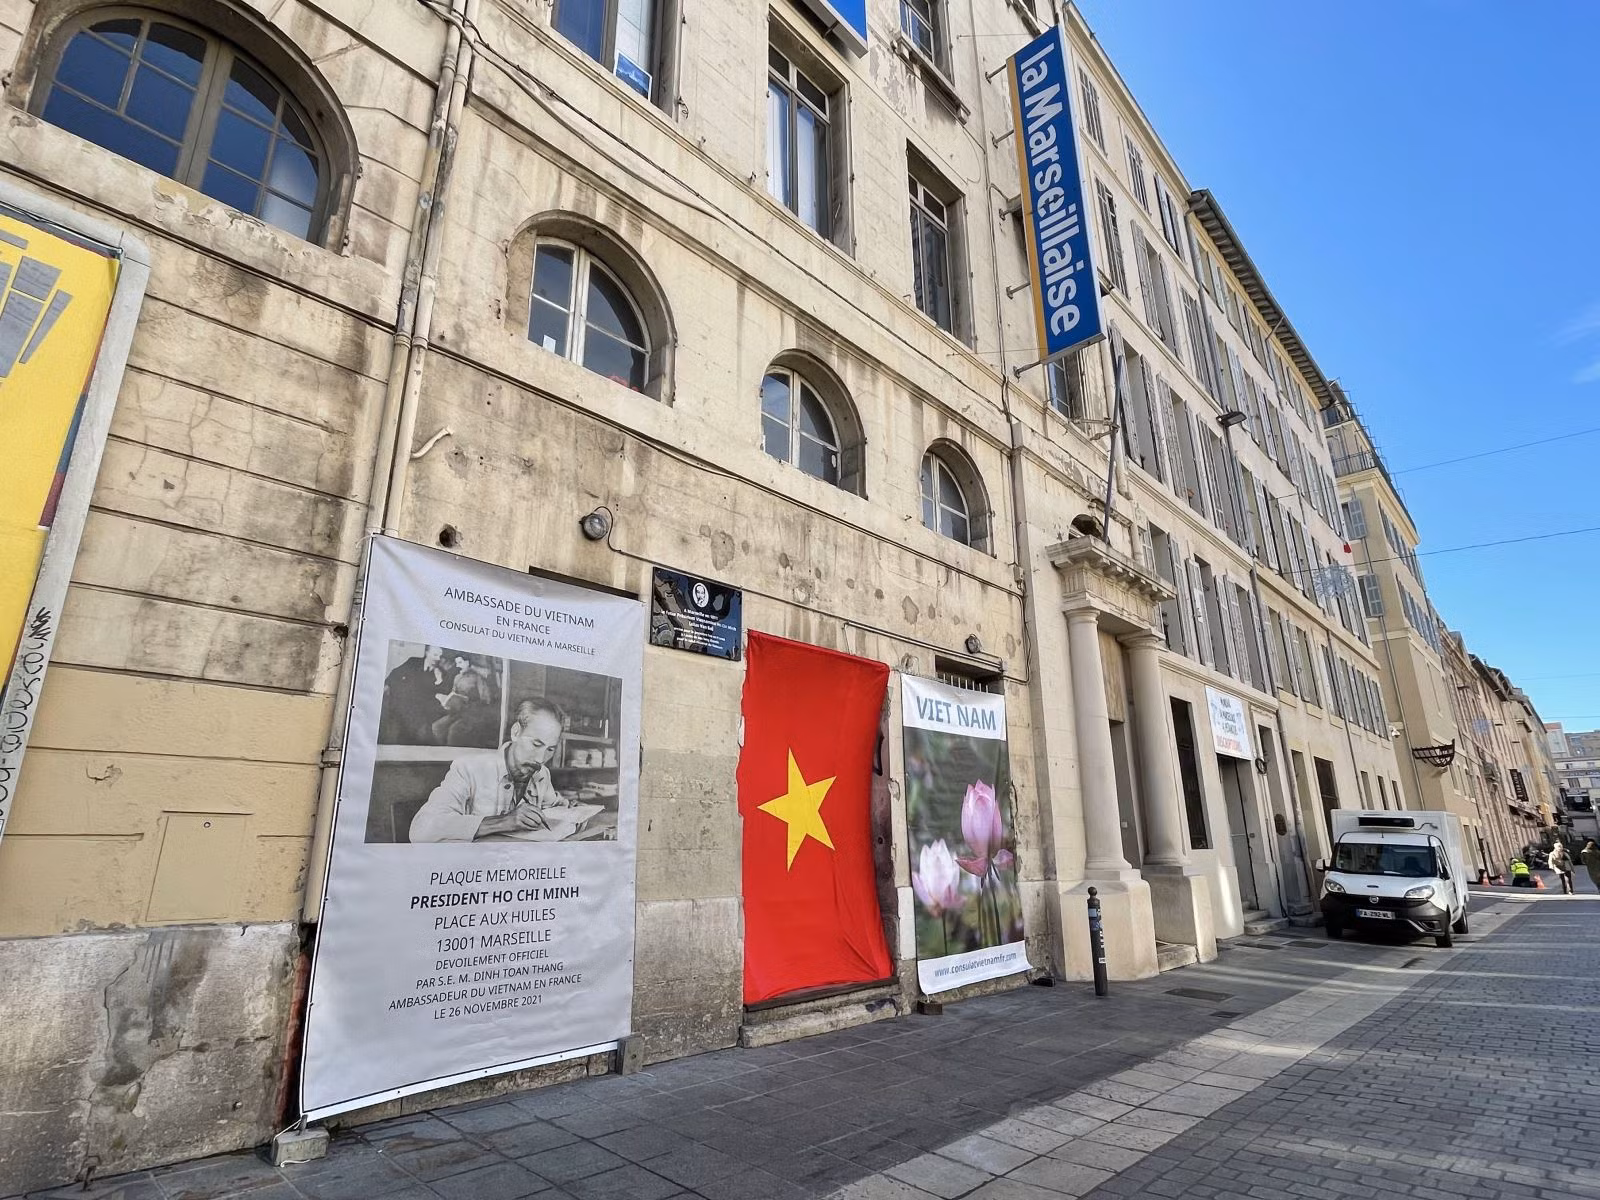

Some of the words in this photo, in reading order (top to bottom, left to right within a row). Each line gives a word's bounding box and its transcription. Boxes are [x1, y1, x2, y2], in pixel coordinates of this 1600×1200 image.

[1020, 43, 1055, 92] la
[1023, 83, 1086, 337] Marseillaise
[444, 587, 521, 614] AMBASSADE
[525, 605, 542, 618] DU
[544, 609, 595, 629] VIETNAM
[440, 619, 491, 637] CONSULAT
[492, 629, 505, 640] DU
[507, 632, 545, 648] VIETNAM
[547, 640, 553, 648] A
[554, 640, 596, 656] MARSEILLE
[497, 616, 510, 627] EN
[513, 619, 551, 635] FRANCE
[916, 695, 952, 724] VIET
[956, 704, 997, 731] NAM
[430, 870, 483, 886] PLAQUE
[486, 867, 567, 883] MEMORIELLE
[410, 891, 489, 910] PRESIDENT
[492, 890, 513, 903] HO
[517, 889, 540, 901] CHI
[543, 886, 580, 900] MINH
[435, 914, 476, 930] PLACE
[480, 912, 508, 926] AUX
[511, 908, 557, 923] HUILES
[437, 936, 475, 953] 13001
[480, 929, 552, 949] MARSEILLE
[435, 953, 507, 971] DEVOILEMENT
[509, 949, 549, 962] OFFICIEL
[934, 951, 1017, 977] www.consulatvietnamfr.com
[416, 977, 436, 990] PAR
[438, 975, 456, 986] S.E.
[458, 974, 471, 984] M.
[474, 969, 500, 982] DINH
[503, 966, 530, 978] TOAN
[532, 962, 564, 974] THANG
[389, 990, 468, 1011] AMBASSADEUR
[470, 987, 486, 998] DU
[488, 981, 532, 996] VIETNAM
[534, 979, 547, 988] EN
[549, 974, 582, 987] FRANCE
[434, 1009, 446, 1020] LE
[449, 1008, 461, 1018] 26
[464, 998, 519, 1016] NOVEMBRE
[521, 994, 542, 1005] 2021
